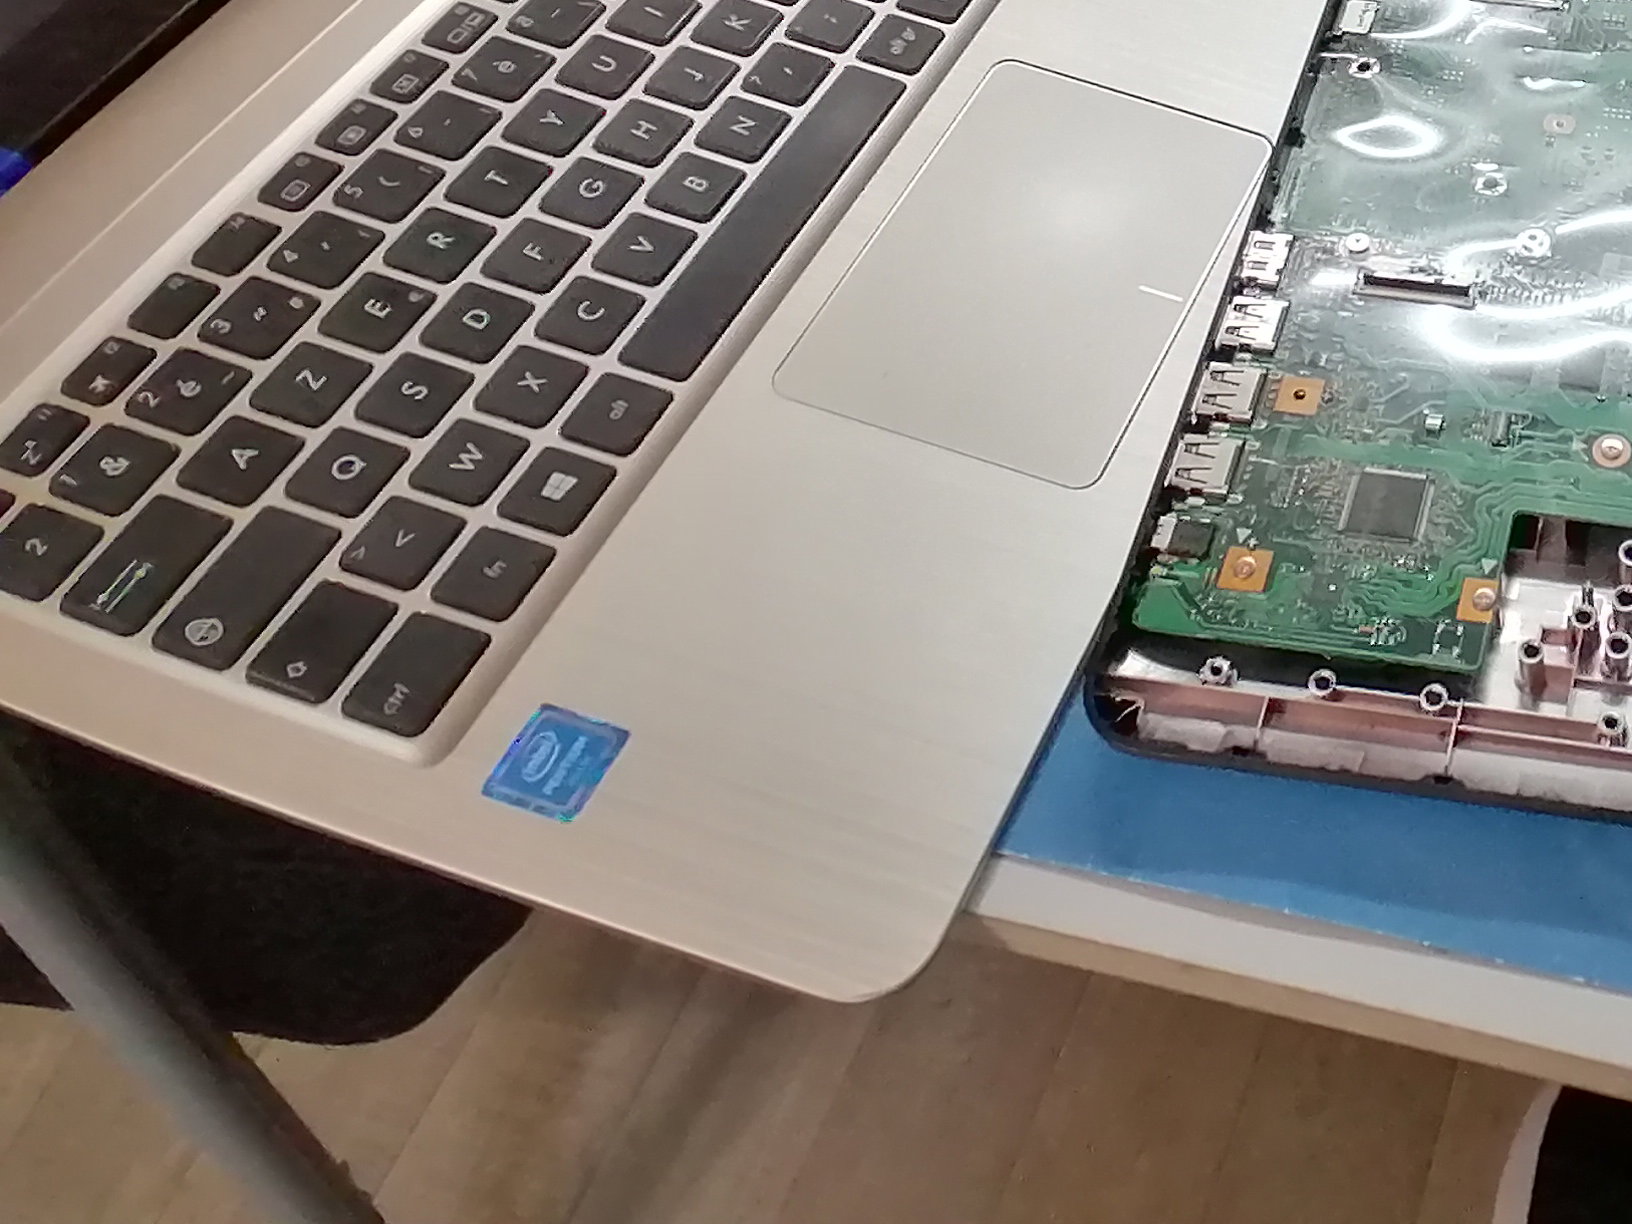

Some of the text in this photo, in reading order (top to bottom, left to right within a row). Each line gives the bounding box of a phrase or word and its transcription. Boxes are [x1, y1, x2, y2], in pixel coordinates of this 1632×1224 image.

[136, 390, 160, 407] 2
[209, 317, 231, 333] 3
[282, 249, 298, 262] 4
[343, 183, 363, 198] 5
[230, 448, 259, 469] A
[295, 369, 327, 390] Z
[363, 298, 391, 318] E
[426, 231, 453, 249] R
[483, 169, 508, 185] T
[538, 109, 563, 125] Y
[591, 54, 616, 72] U
[330, 454, 366, 480] Q
[400, 380, 428, 400] S
[461, 308, 490, 329] D
[522, 242, 542, 260] F
[578, 177, 605, 198] G
[630, 119, 657, 139] H
[683, 67, 703, 81] J
[723, 14, 750, 30] K
[448, 442, 483, 470] W
[516, 370, 547, 392] X
[576, 300, 605, 320] C
[629, 235, 654, 251] V
[682, 175, 708, 191] B
[729, 114, 755, 135] N
[99, 456, 130, 476] &
